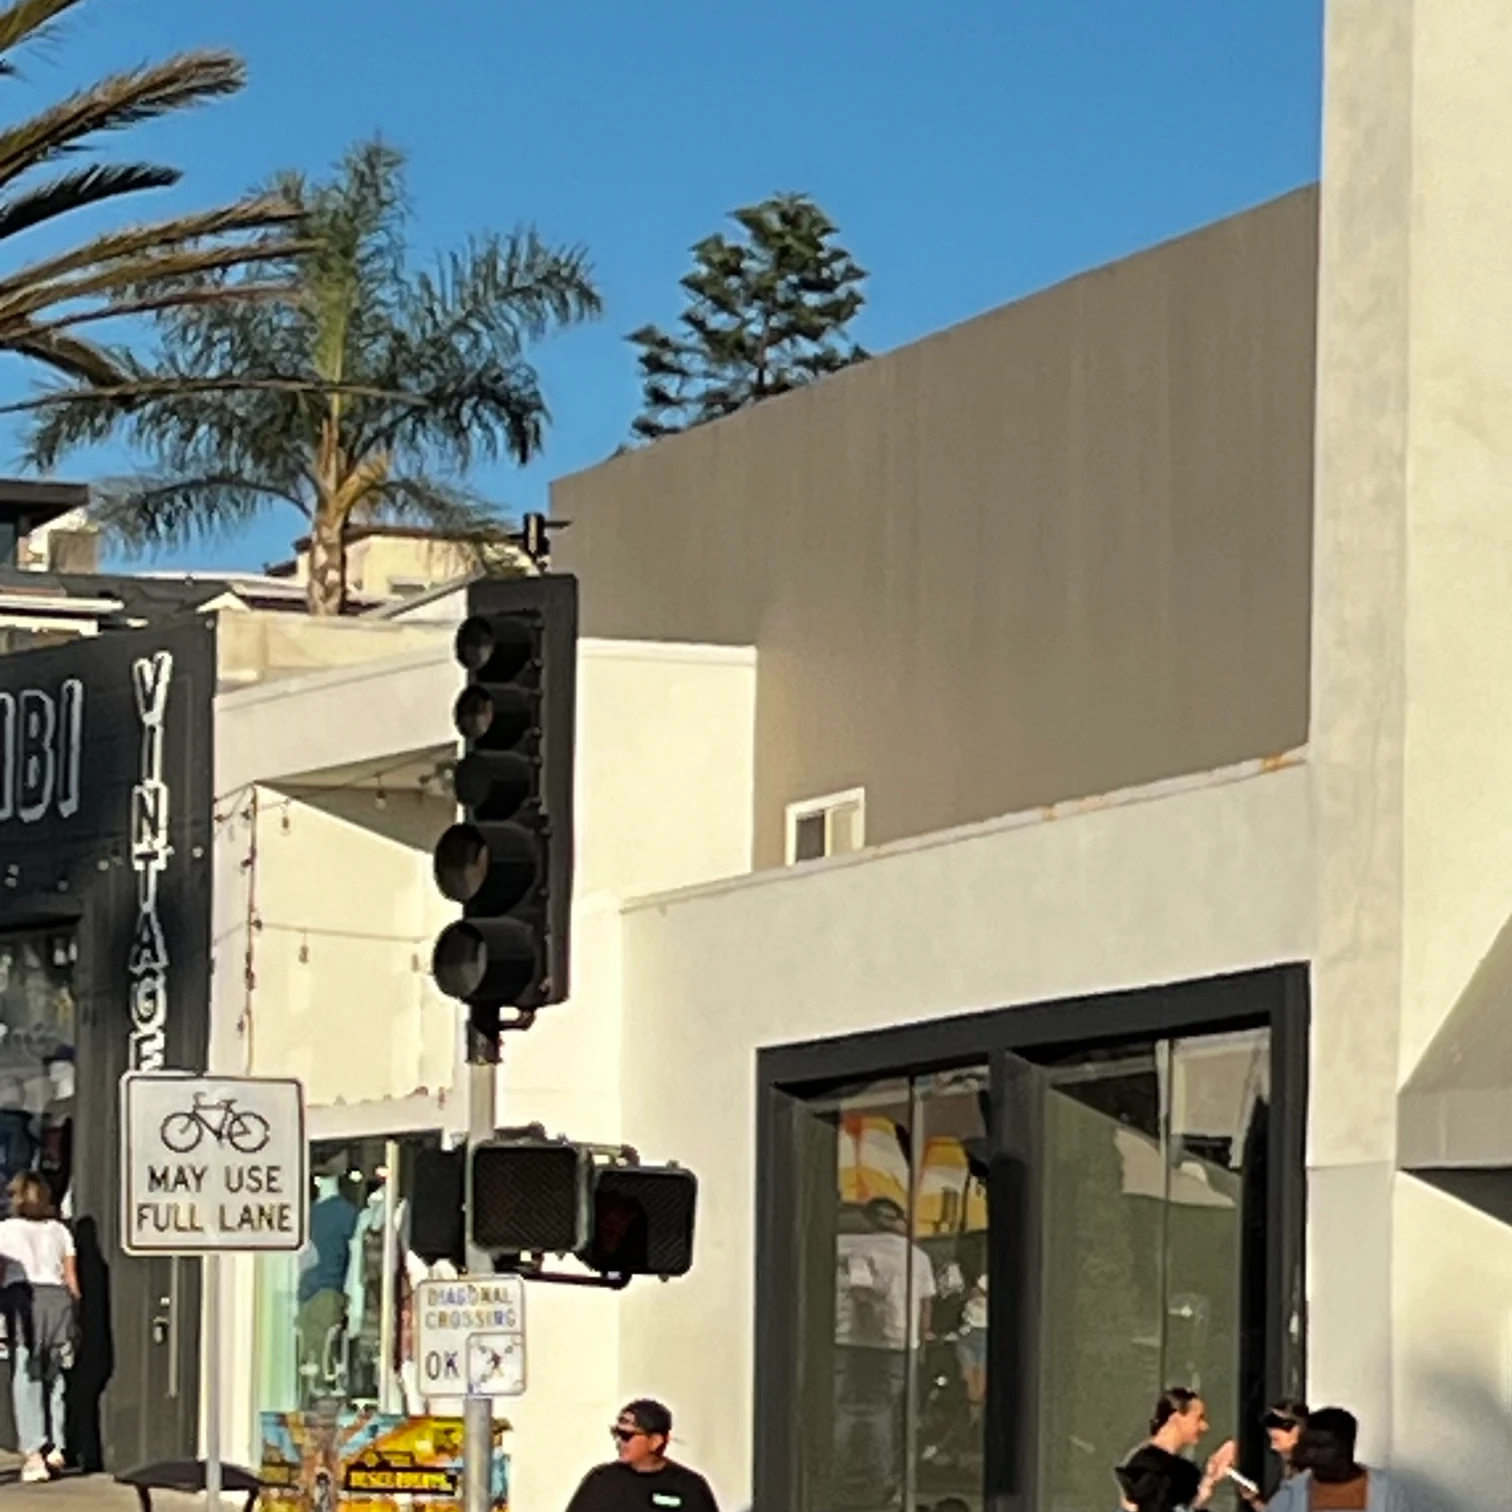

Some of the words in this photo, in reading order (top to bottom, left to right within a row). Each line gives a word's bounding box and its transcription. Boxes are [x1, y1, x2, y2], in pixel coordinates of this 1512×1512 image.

[147, 1165, 208, 1193] MAY
[225, 1165, 282, 1193] USE
[137, 1203, 203, 1232] FULL
[219, 1203, 293, 1232] LANE
[427, 1284, 513, 1306] DIAGONAL
[425, 1308, 516, 1330] CROSSING
[425, 1350, 459, 1381] OK
